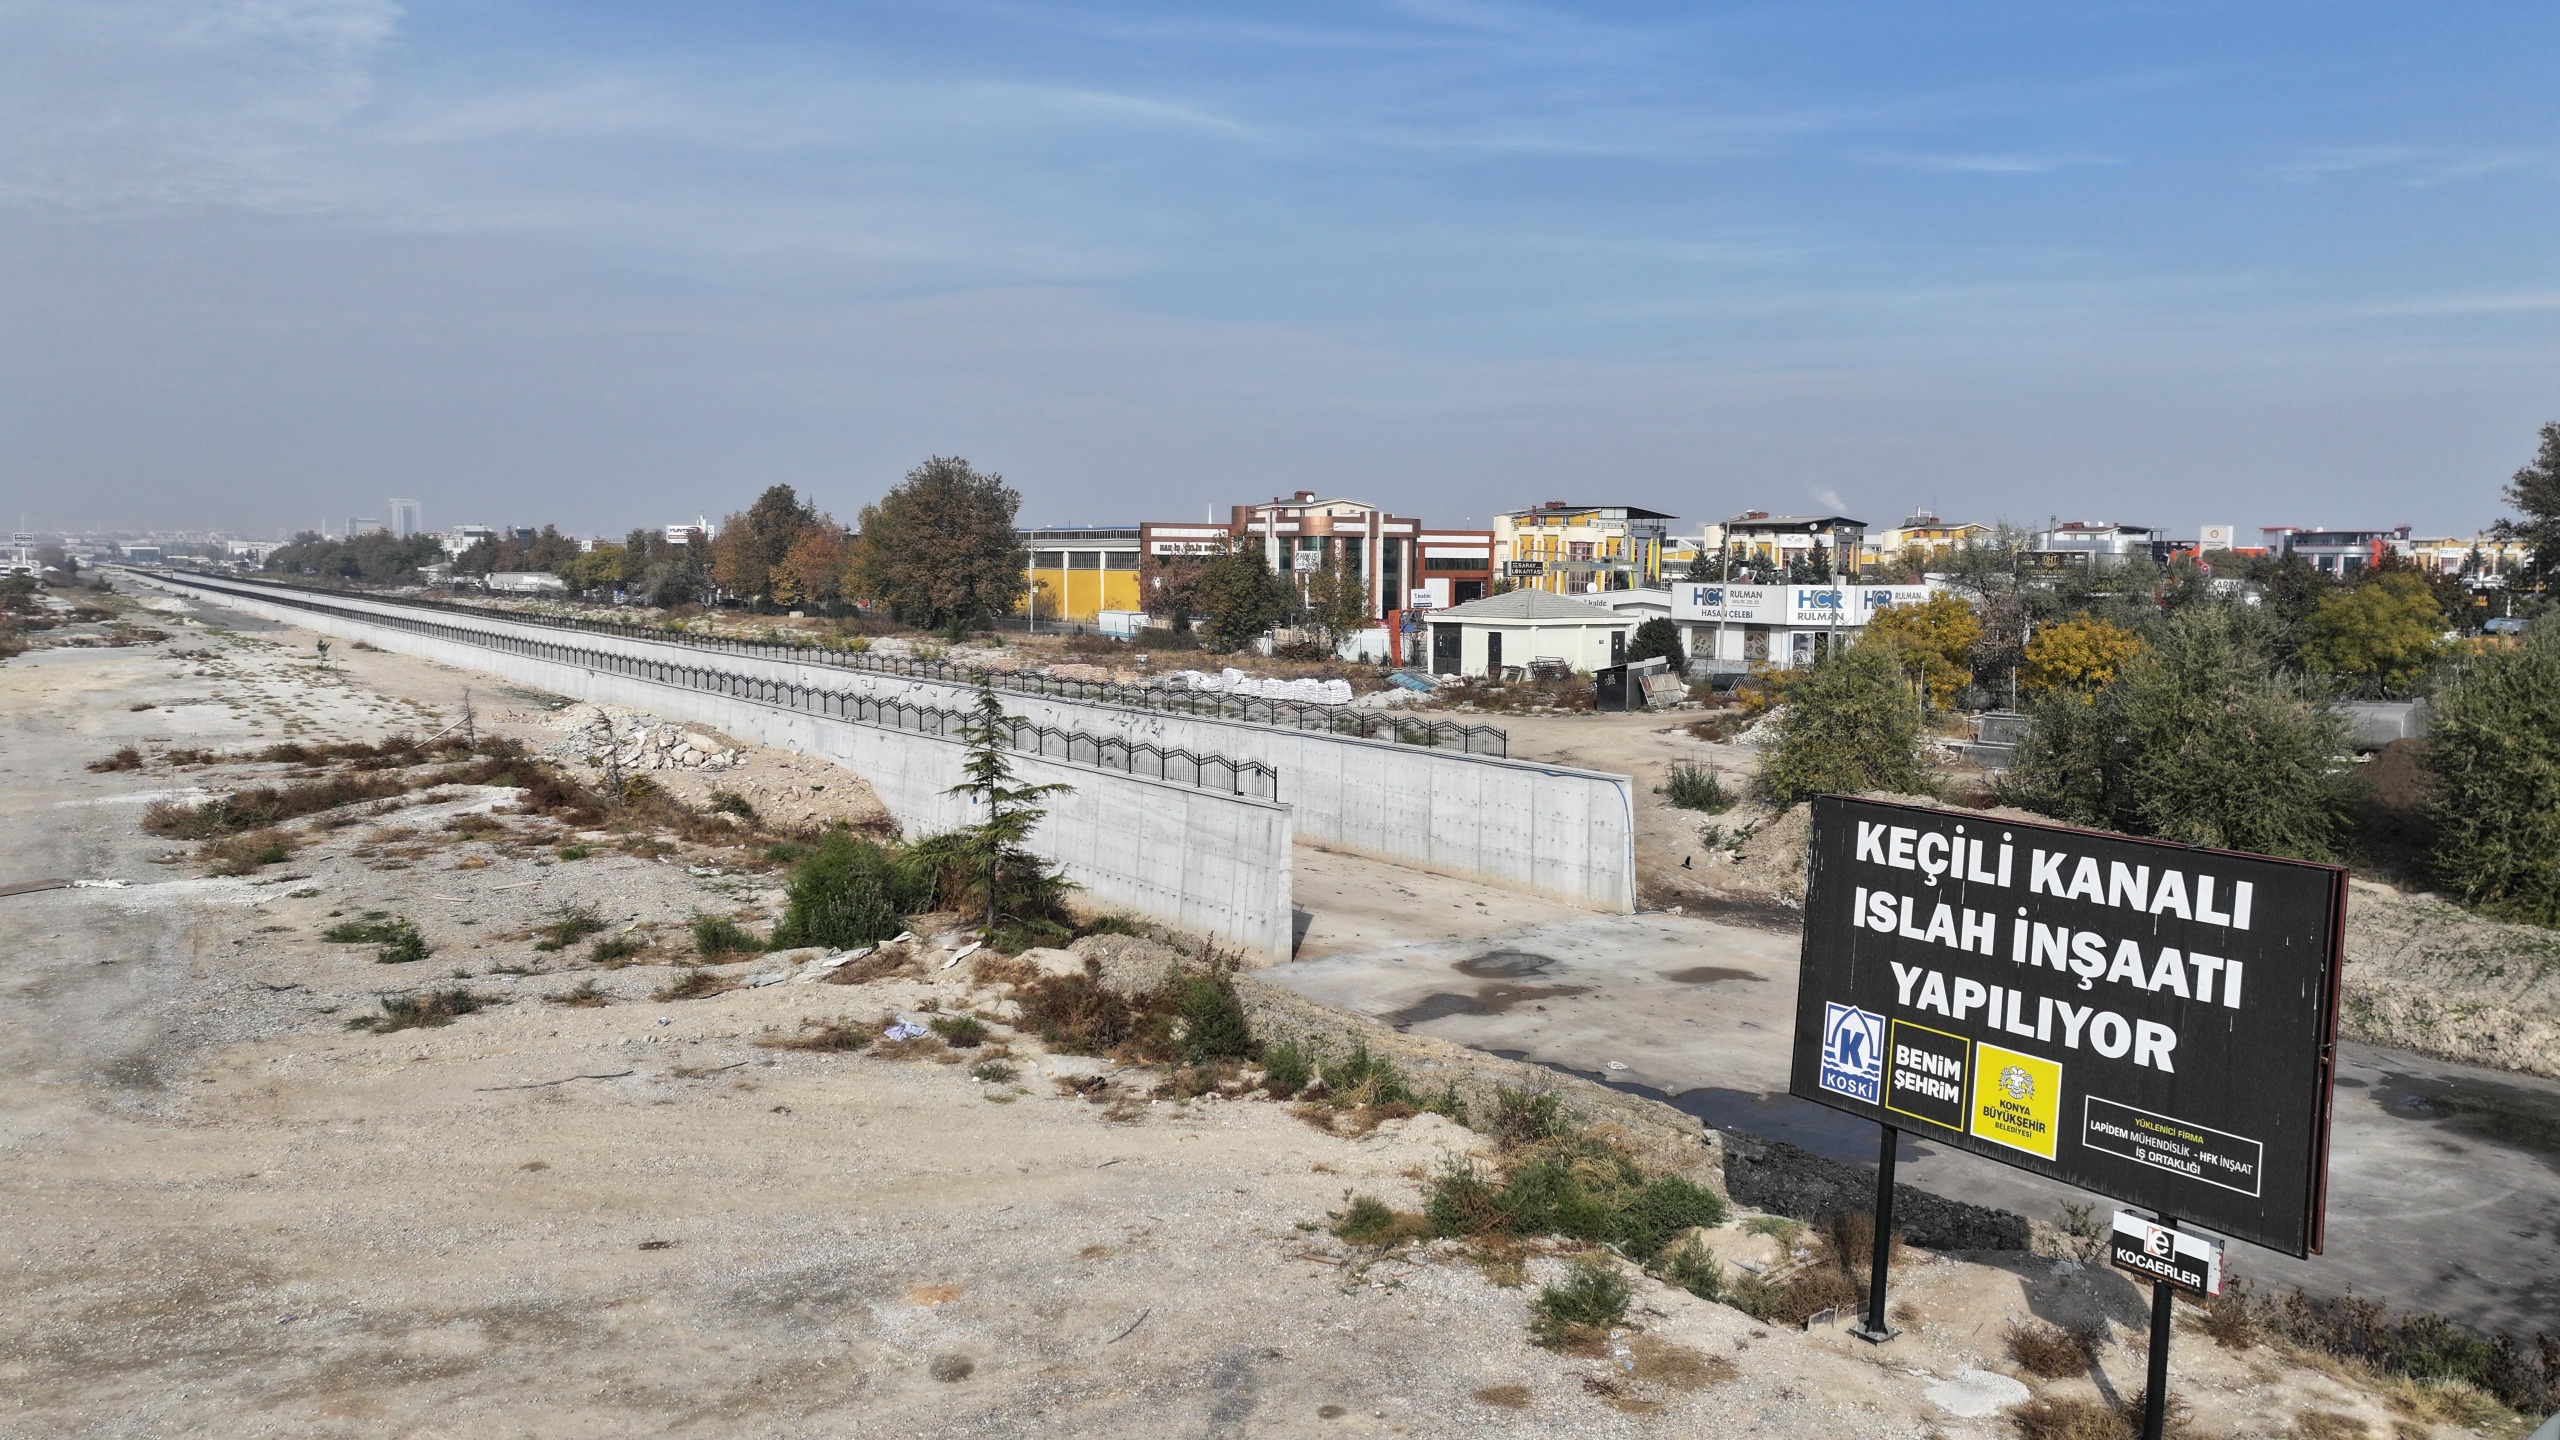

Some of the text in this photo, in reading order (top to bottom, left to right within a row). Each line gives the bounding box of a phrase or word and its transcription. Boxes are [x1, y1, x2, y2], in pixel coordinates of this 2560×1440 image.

[1729, 590, 1763, 599] RULMAN
[1798, 589, 1843, 609] HCR
[1863, 590, 1893, 610] HCR
[1894, 591, 1921, 600] RULMAN
[1728, 609, 1753, 620] ÇELEBİ
[1855, 821, 2254, 930] KEÇİLİ KANALI
[1852, 886, 2244, 1009] ISLAH İNŞAATI
[1889, 960, 2177, 1074] YAPILIYOR
[1826, 1072, 1873, 1098] KOSKİ
[1982, 1105, 2046, 1134] BÜYÜKŞEHİR
[1999, 1099, 2031, 1116] KONYA
[1994, 1122, 2032, 1139] BELEDİYESİ
[2134, 1118, 2204, 1144] YÜKLENİCİ FİRMA
[2090, 1120, 2129, 1140] LAPİDEM
[2130, 1131, 2190, 1158] MÜHENDİSLİK
[2199, 1151, 2218, 1166] HFK
[2219, 1157, 2253, 1175] İNŞAAT
[2135, 1146, 2201, 1175] İŞ ORTAKLIĞI
[2116, 1247, 2201, 1288] KOCAERLER
